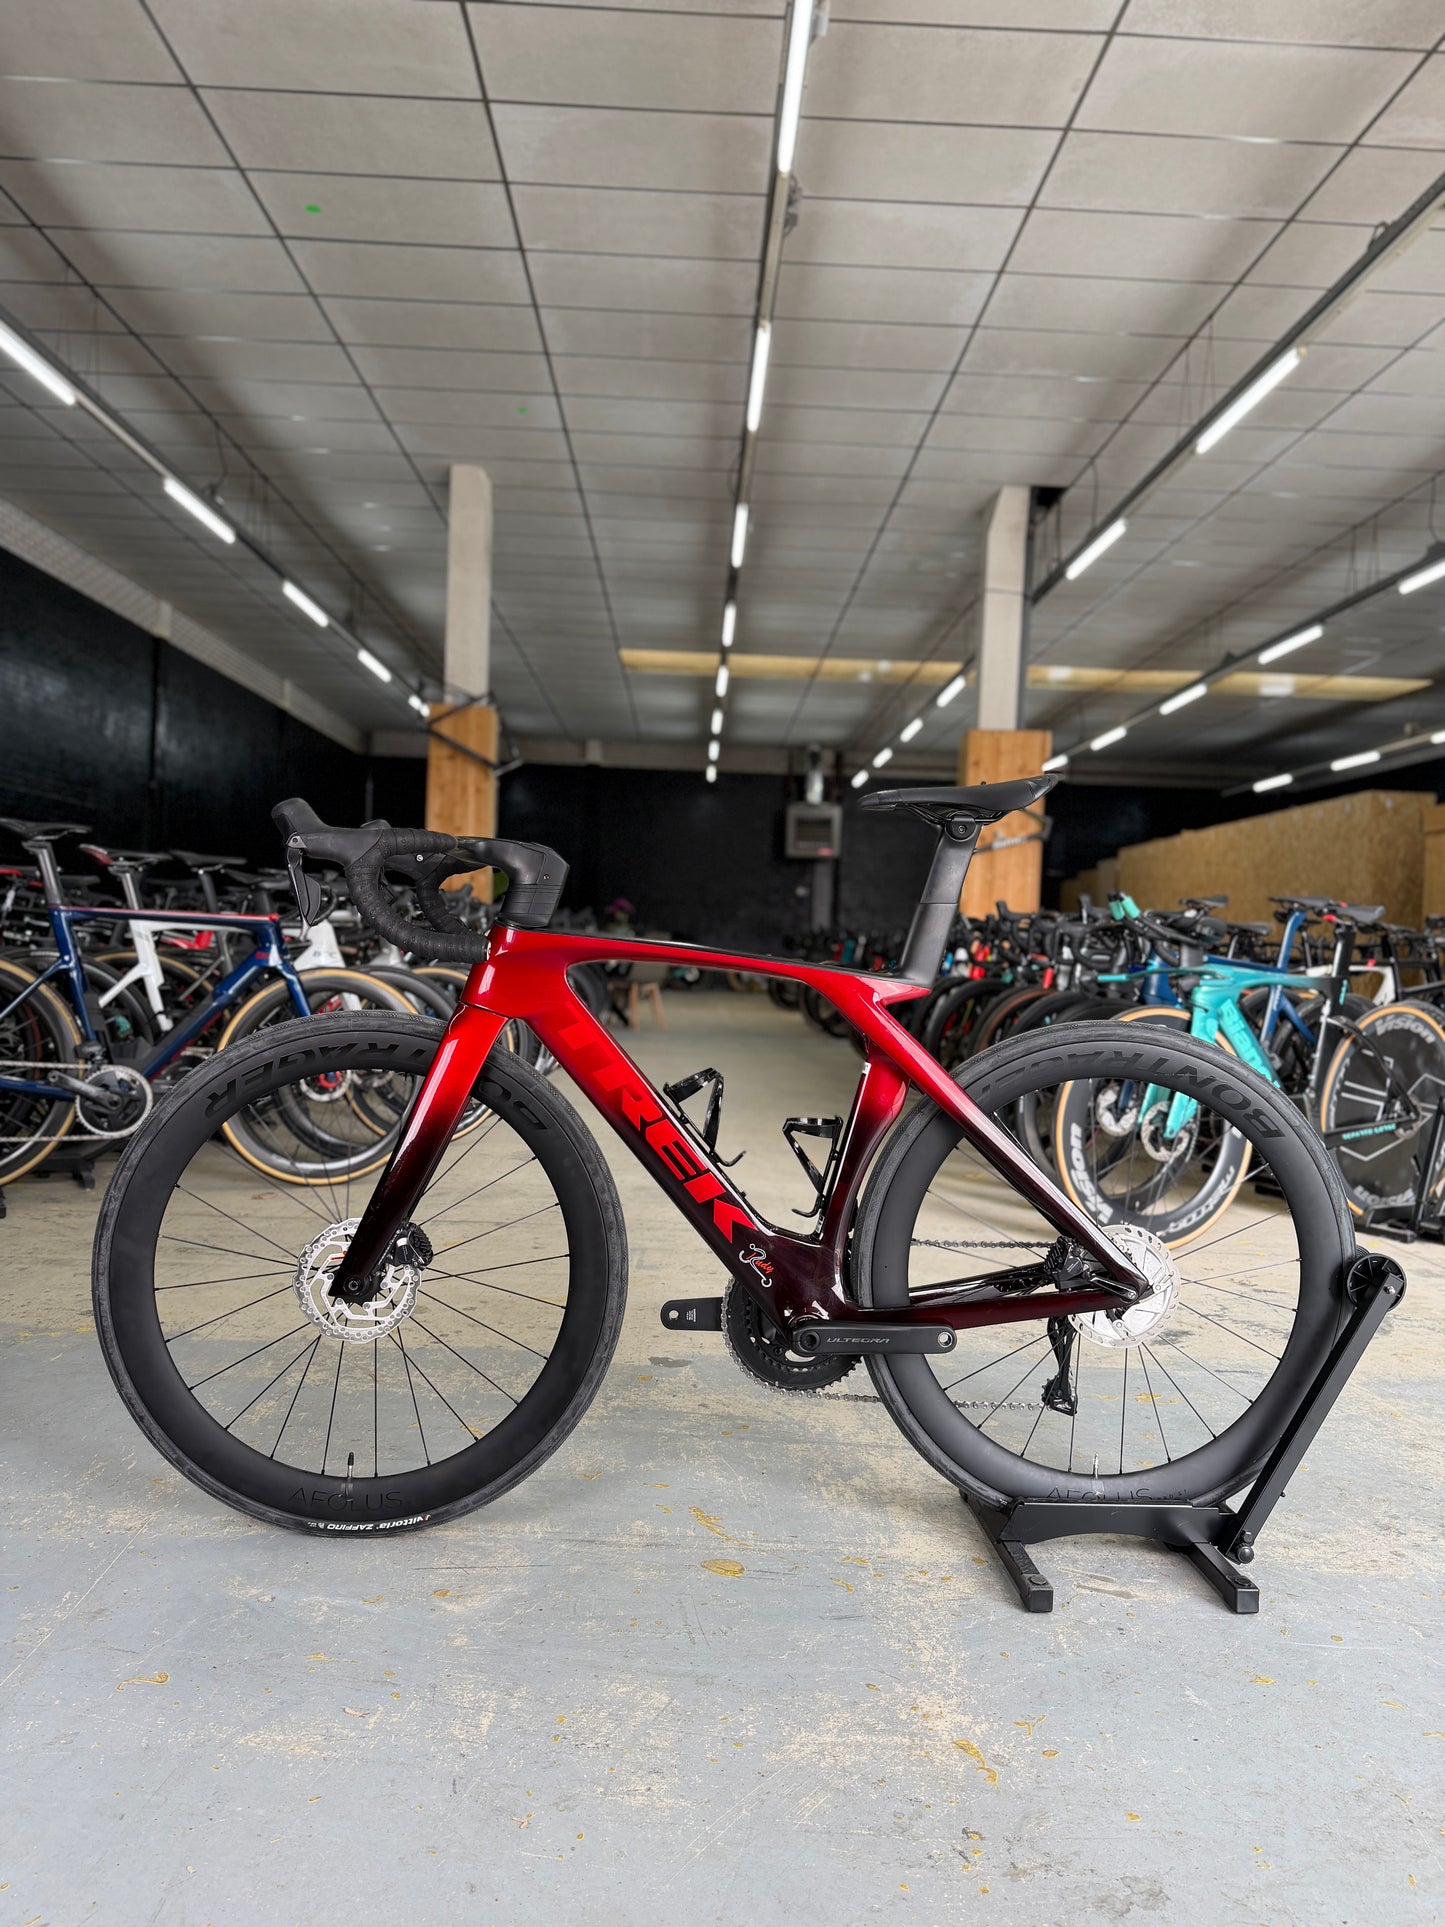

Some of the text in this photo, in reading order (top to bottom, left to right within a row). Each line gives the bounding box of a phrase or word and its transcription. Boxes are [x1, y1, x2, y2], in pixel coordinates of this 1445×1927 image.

[1219, 998, 1281, 1089] Bianc
[1374, 1014, 1436, 1045] Vision
[205, 1042, 548, 1130] BOTRAGER
[556, 1000, 759, 1244] TREK
[1070, 1122, 1114, 1225] Vision
